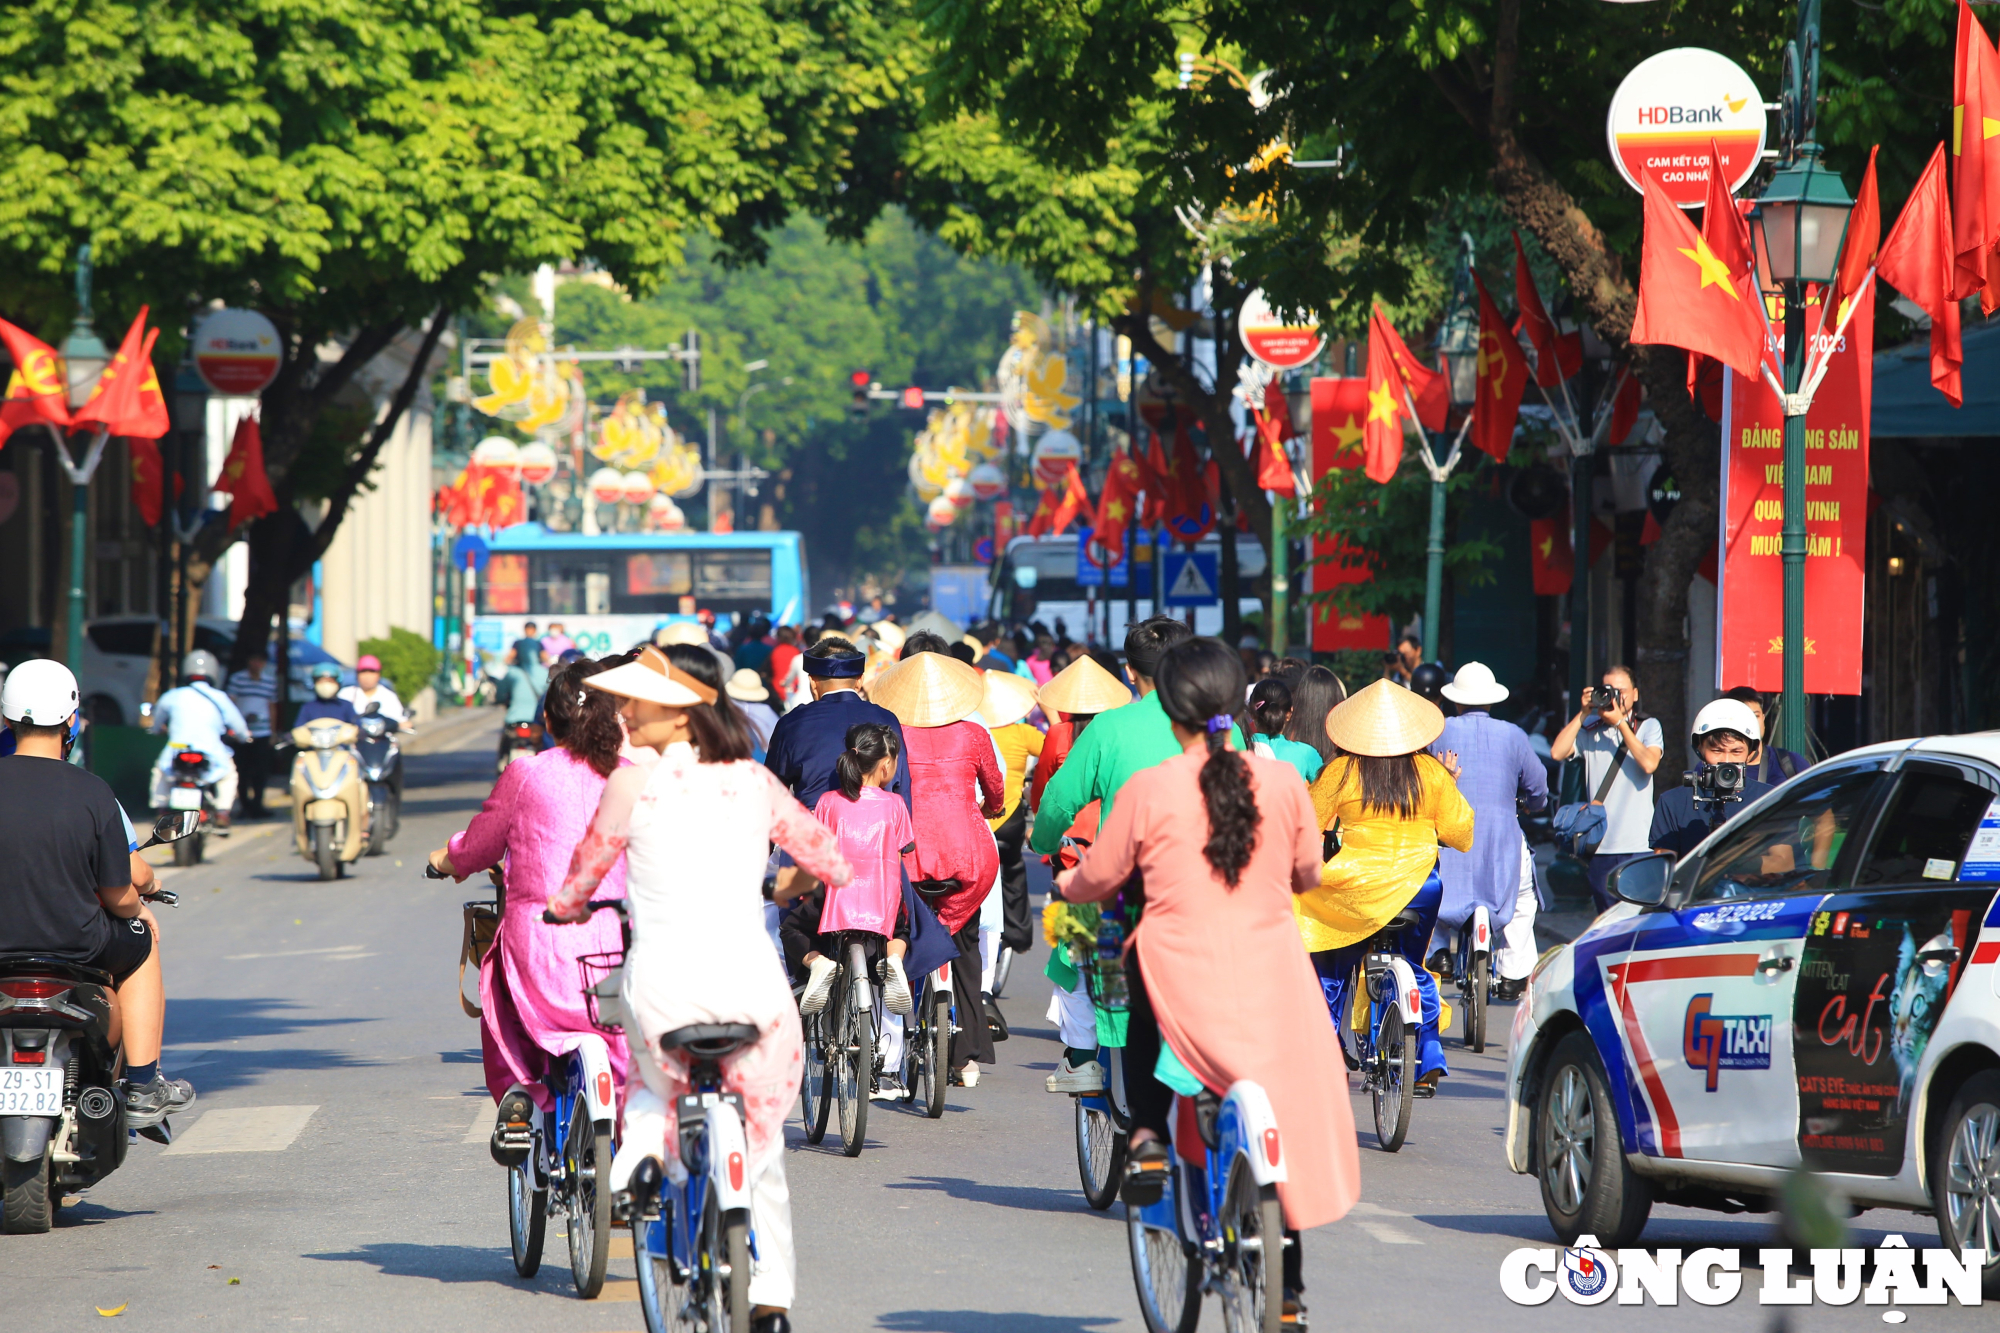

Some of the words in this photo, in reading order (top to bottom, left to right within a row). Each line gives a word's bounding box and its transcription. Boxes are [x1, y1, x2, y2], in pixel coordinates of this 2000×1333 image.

[1638, 105, 1723, 125] HDBank
[1647, 157, 1670, 167] CAM
[1672, 154, 1691, 167] KẾT
[1662, 171, 1684, 182] CAO
[1686, 168, 1709, 182] NHẤ
[1742, 422, 1781, 448] ĐẢNG
[1829, 423, 1858, 450] SẢN
[1806, 501, 1840, 521] VINH
[1683, 993, 1724, 1093] G7
[1723, 1018, 1770, 1054] TAXI
[3, 1070, 51, 1090] 29-S1
[1827, 1077, 1846, 1095] EYE
